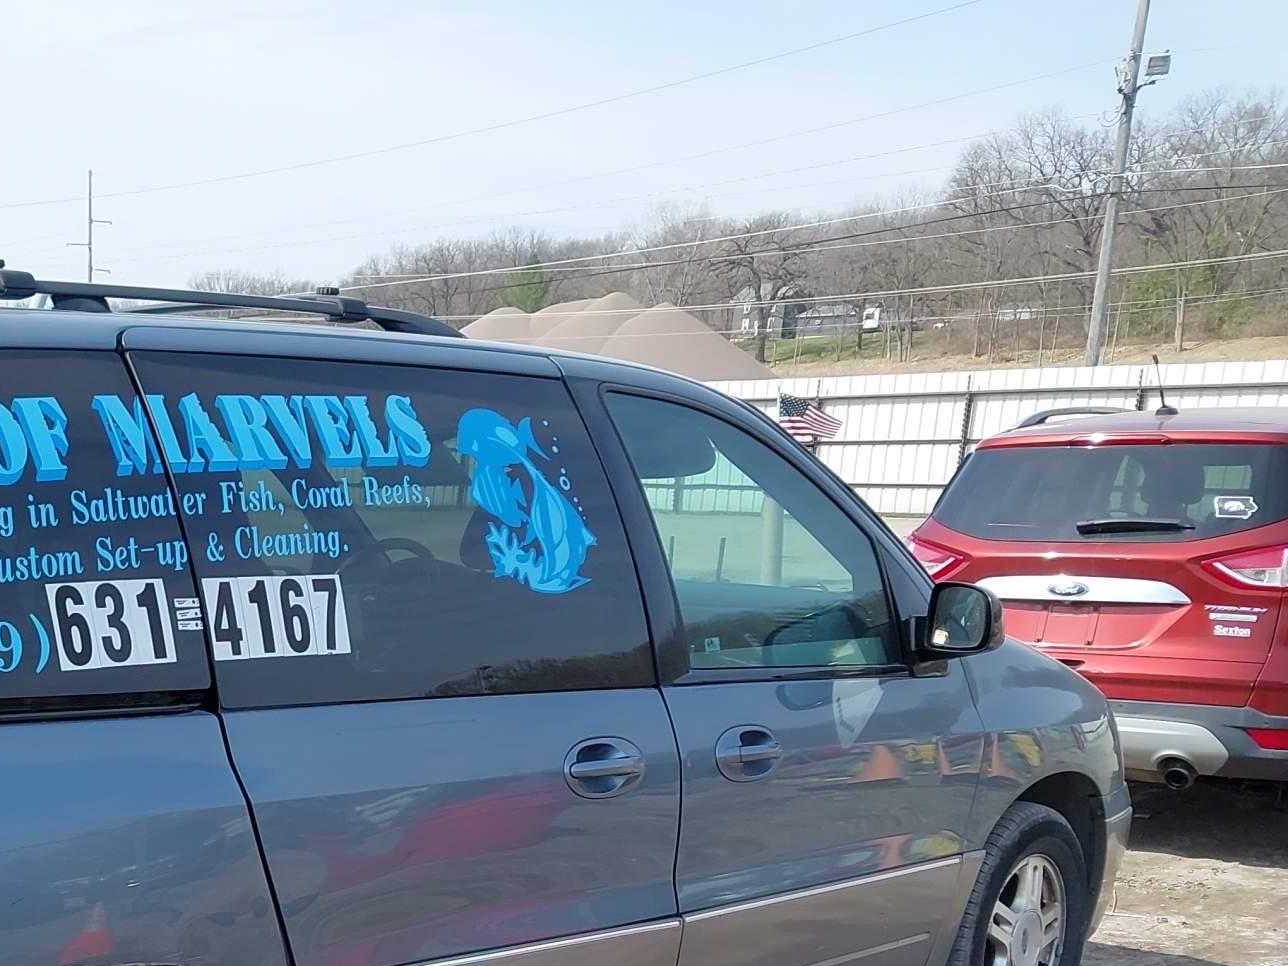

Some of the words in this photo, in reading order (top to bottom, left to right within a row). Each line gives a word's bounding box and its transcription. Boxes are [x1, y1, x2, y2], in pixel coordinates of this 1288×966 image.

[91, 391, 431, 477] MARVELS
[27, 493, 59, 528] in
[71, 484, 206, 525] Saltwater
[220, 480, 285, 517] Fish,
[291, 477, 352, 511] Coral
[362, 474, 431, 508] Reefs,
[95, 535, 190, 572] Set-up
[206, 531, 225, 562] &
[234, 523, 350, 560] Cleaning.
[54, 582, 168, 666] 631
[213, 578, 339, 656] 4167
[1213, 624, 1251, 637] Sexton
